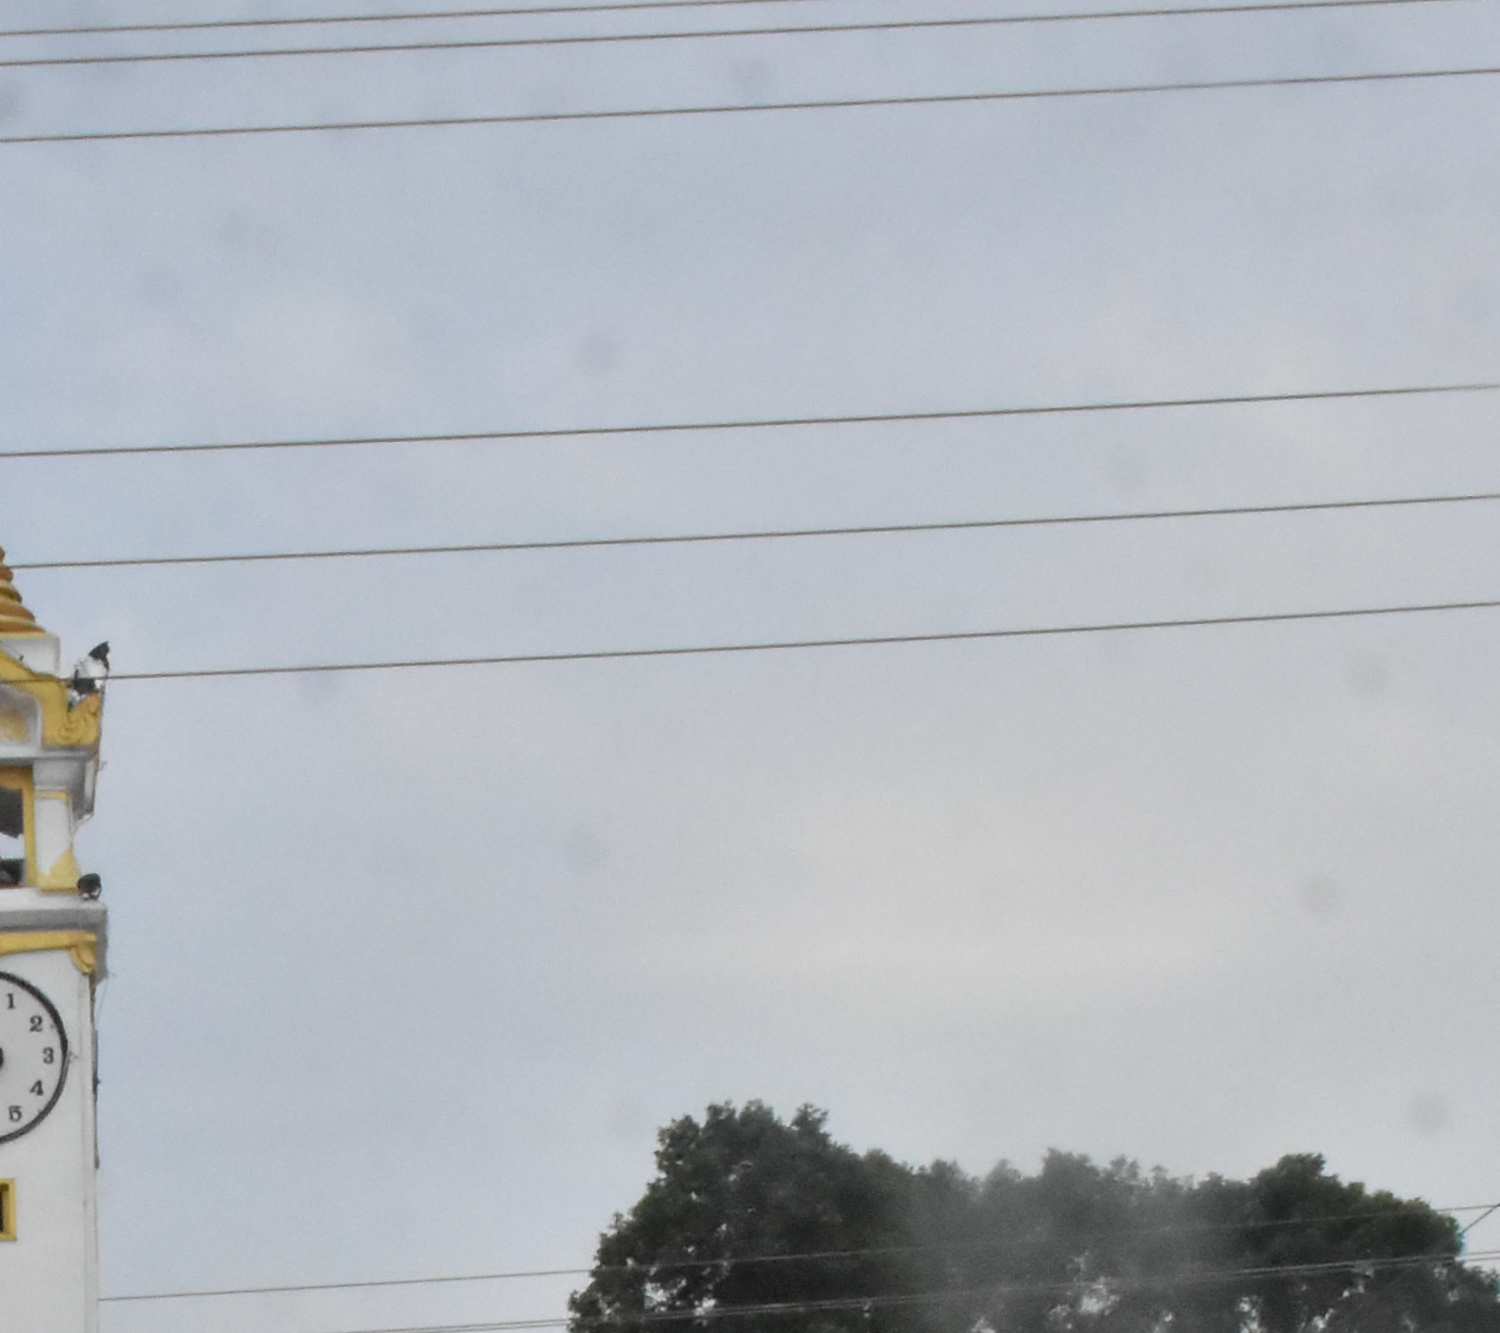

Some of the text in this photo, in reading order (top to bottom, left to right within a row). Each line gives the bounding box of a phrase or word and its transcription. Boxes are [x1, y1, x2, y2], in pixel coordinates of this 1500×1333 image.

[6, 993, 16, 1009] 1
[30, 1015, 43, 1032] 2
[43, 1048, 54, 1065] 3
[29, 1080, 44, 1096] 4
[8, 1105, 22, 1123] 5
